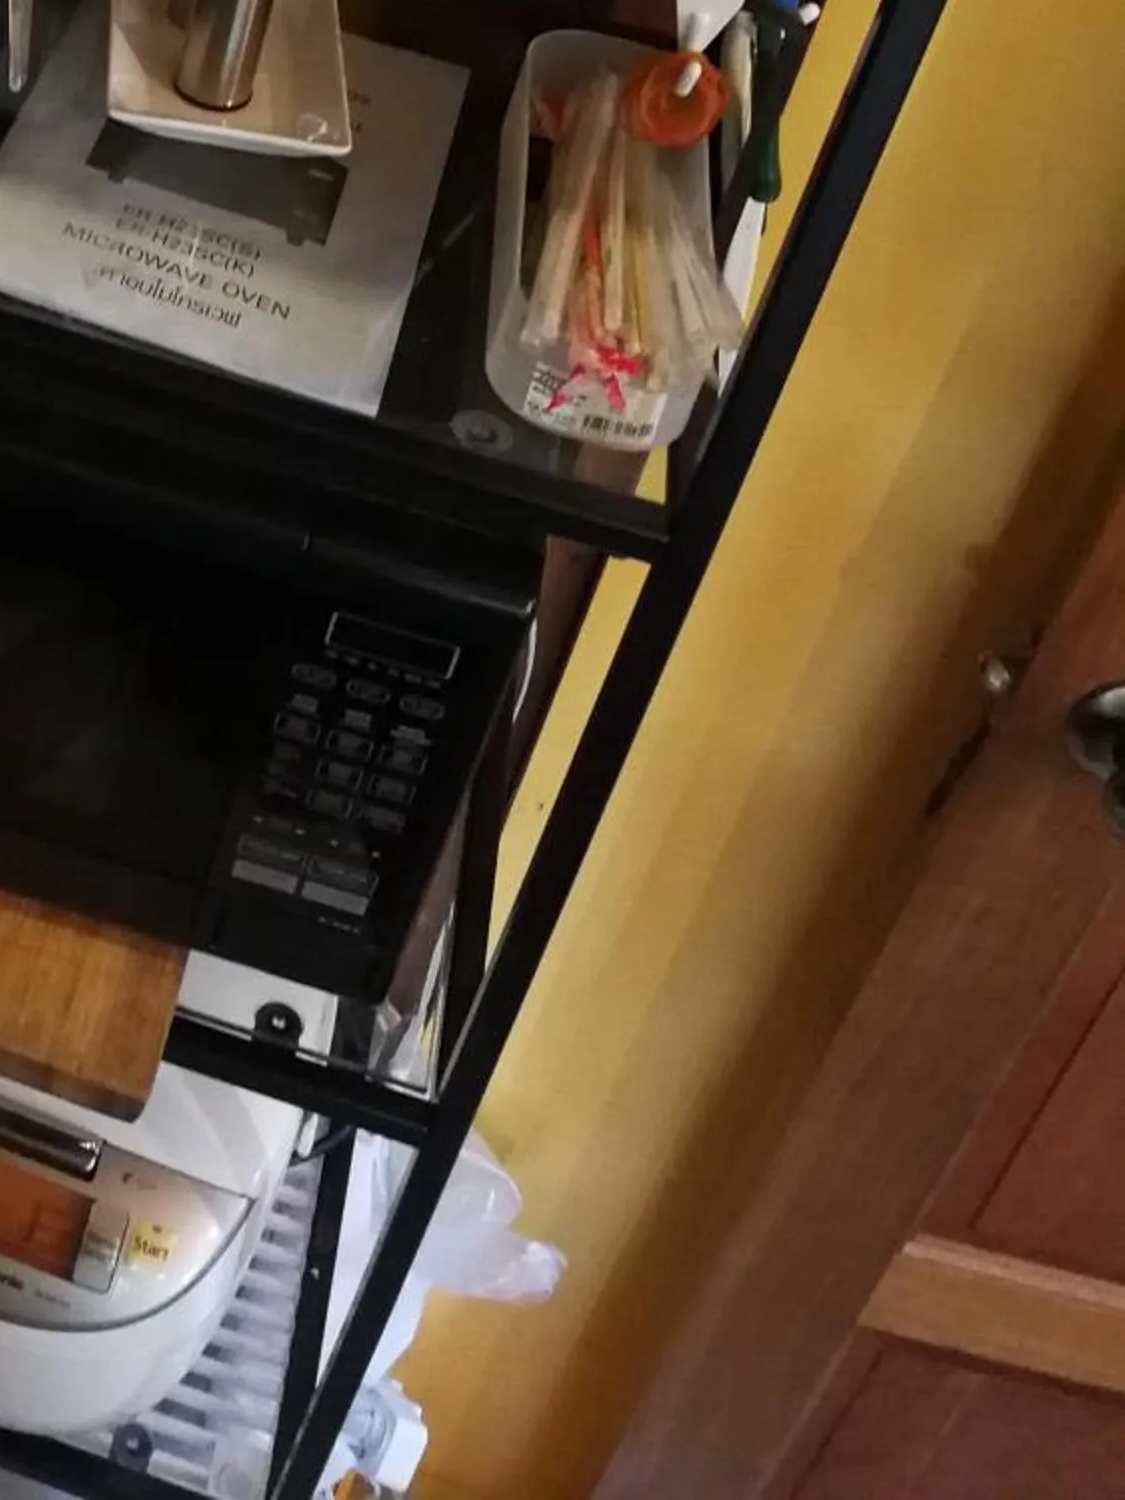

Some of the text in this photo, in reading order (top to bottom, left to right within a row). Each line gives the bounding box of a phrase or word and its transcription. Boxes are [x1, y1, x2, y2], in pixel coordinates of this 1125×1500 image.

[60, 222, 292, 322] MICROWAVE OVEN
[131, 1234, 170, 1264] Start
